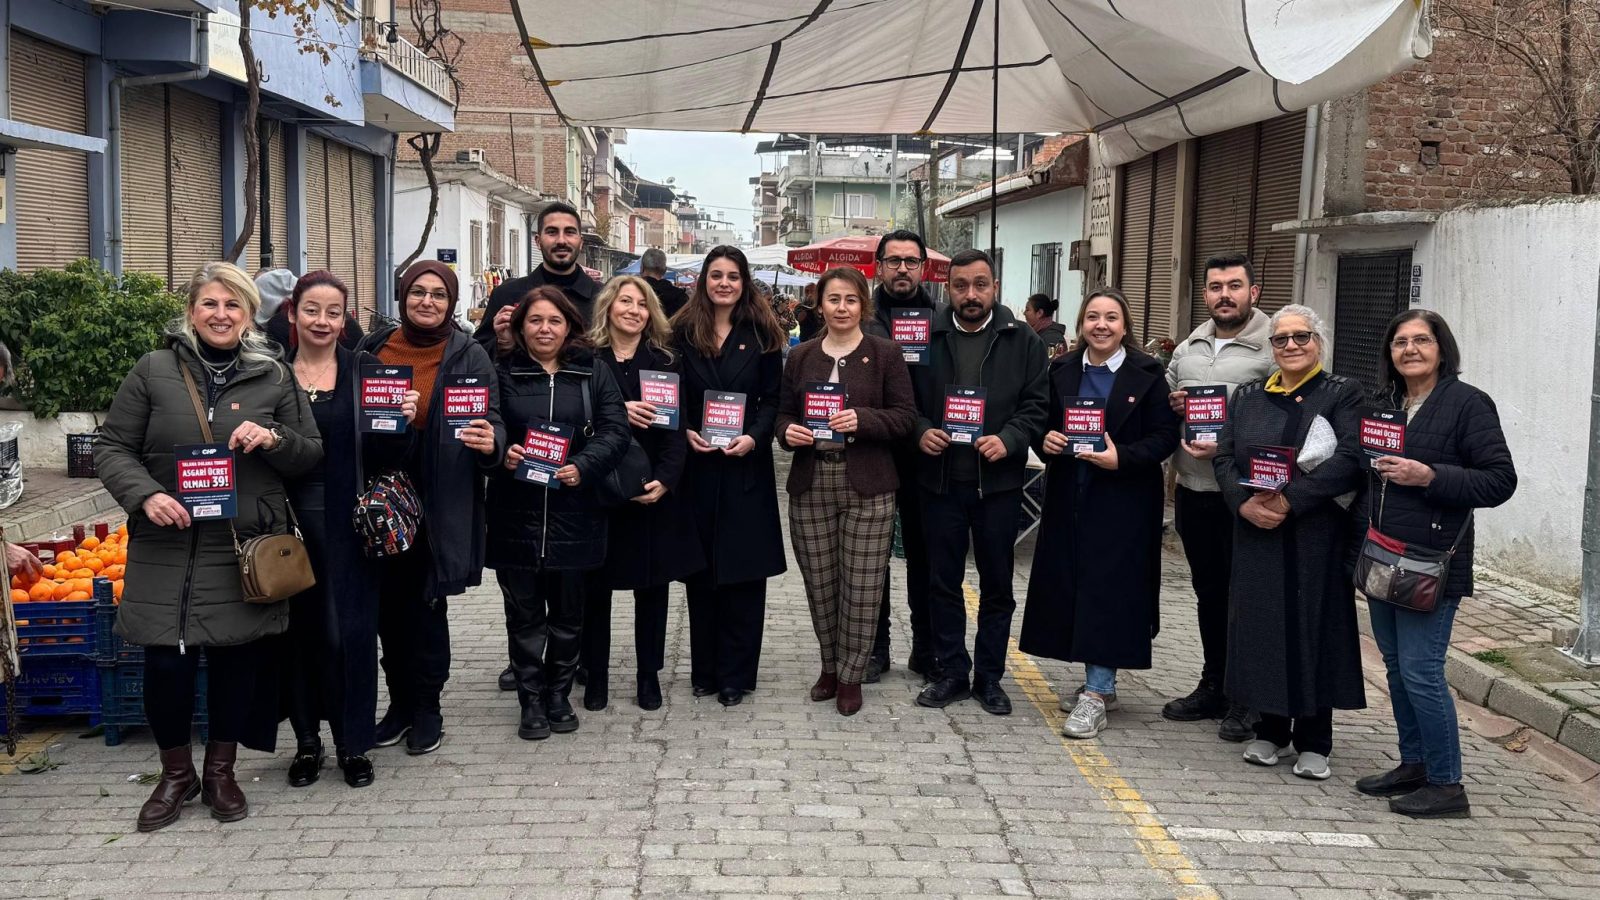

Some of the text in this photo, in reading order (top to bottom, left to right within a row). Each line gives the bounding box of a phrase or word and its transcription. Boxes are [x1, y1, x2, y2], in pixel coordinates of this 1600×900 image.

[915, 332, 926, 340] 39!
[472, 402, 485, 412] 39!
[968, 412, 980, 421] 39!
[1211, 410, 1222, 419] 39!
[1088, 422, 1100, 431] 39!
[1364, 427, 1400, 439] ASGARİ ÜCRET
[1363, 436, 1400, 449] OLMALI 39!
[548, 450, 562, 461] 39!
[182, 467, 228, 476] ASGARİ ÜCRET
[183, 476, 229, 488] OLMALI 39!
